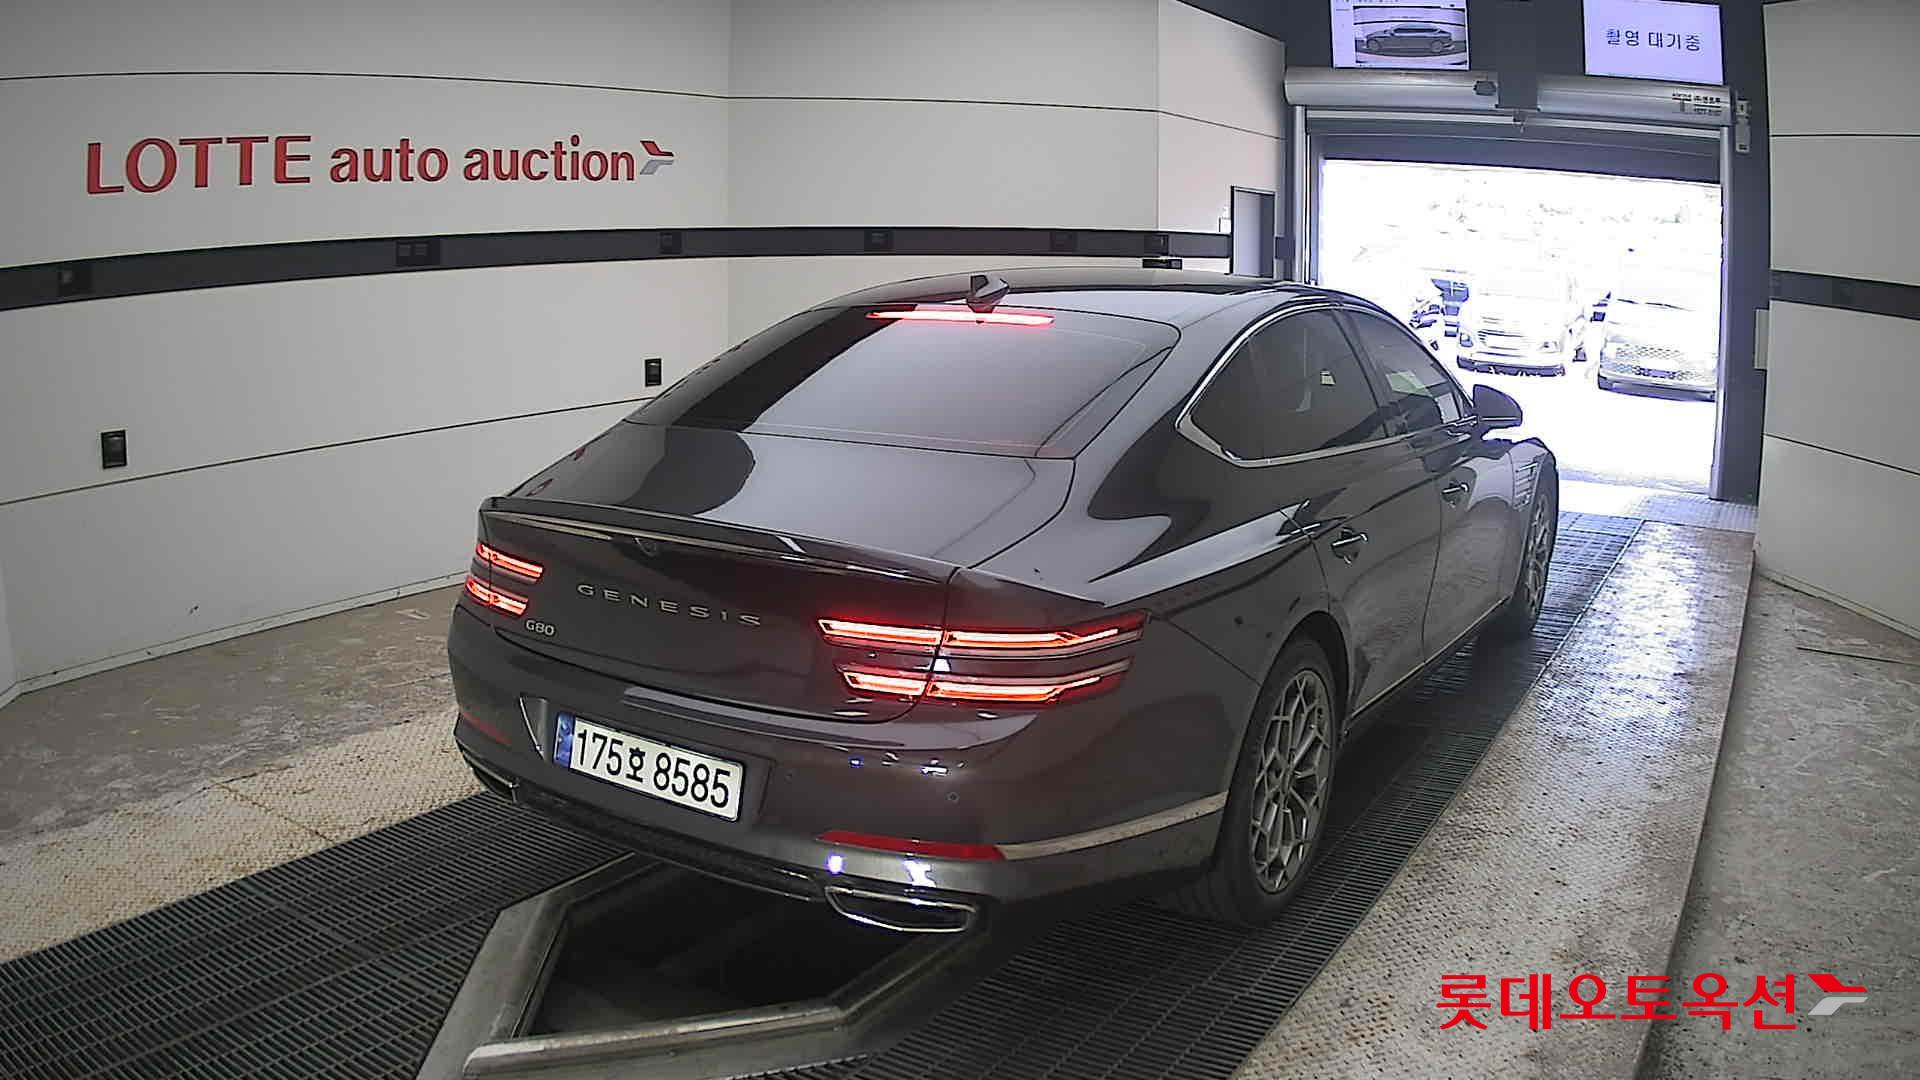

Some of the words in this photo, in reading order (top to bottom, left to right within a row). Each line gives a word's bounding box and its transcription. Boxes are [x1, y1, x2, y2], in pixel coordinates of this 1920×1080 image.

[1647, 31, 1700, 52] 대기중
[86, 135, 312, 195] LOTTE
[329, 138, 449, 183] auto
[463, 134, 635, 182] auction
[577, 583, 761, 626] GENESIS
[525, 618, 555, 637] G80
[577, 729, 646, 783] 175호
[653, 752, 731, 809] 8585
